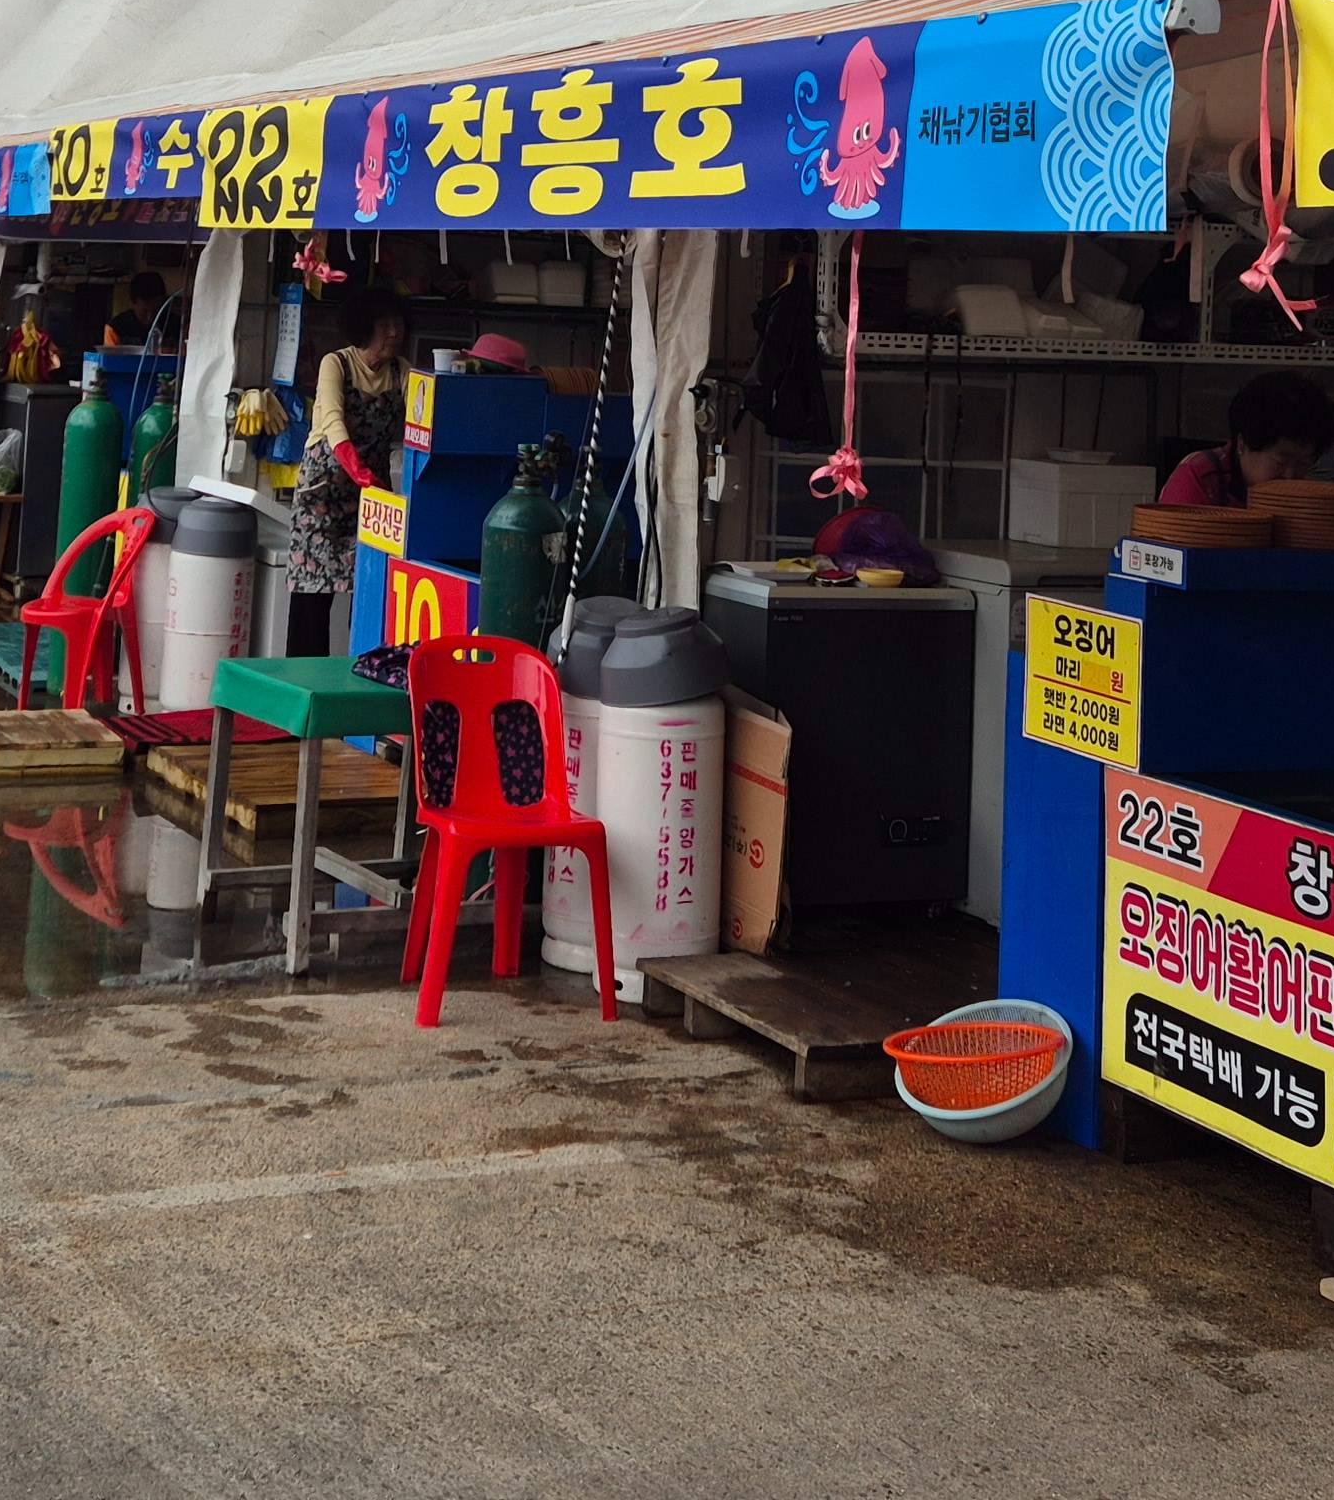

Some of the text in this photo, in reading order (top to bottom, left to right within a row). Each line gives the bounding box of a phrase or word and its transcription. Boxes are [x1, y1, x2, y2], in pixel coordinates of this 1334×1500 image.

[425, 57, 747, 218] 창흥호
[918, 99, 1036, 146] 채낚기협회
[51, 123, 104, 197] 10호
[208, 105, 318, 225] 22호
[1053, 613, 1116, 660] 오징어
[1055, 655, 1081, 682] 마리
[1042, 711, 1119, 752] 라면 4,000원
[1043, 686, 1120, 726] 햇반 2,000원
[1118, 787, 1206, 873] 22호
[1132, 1007, 1320, 1131] 전국택배 가능
